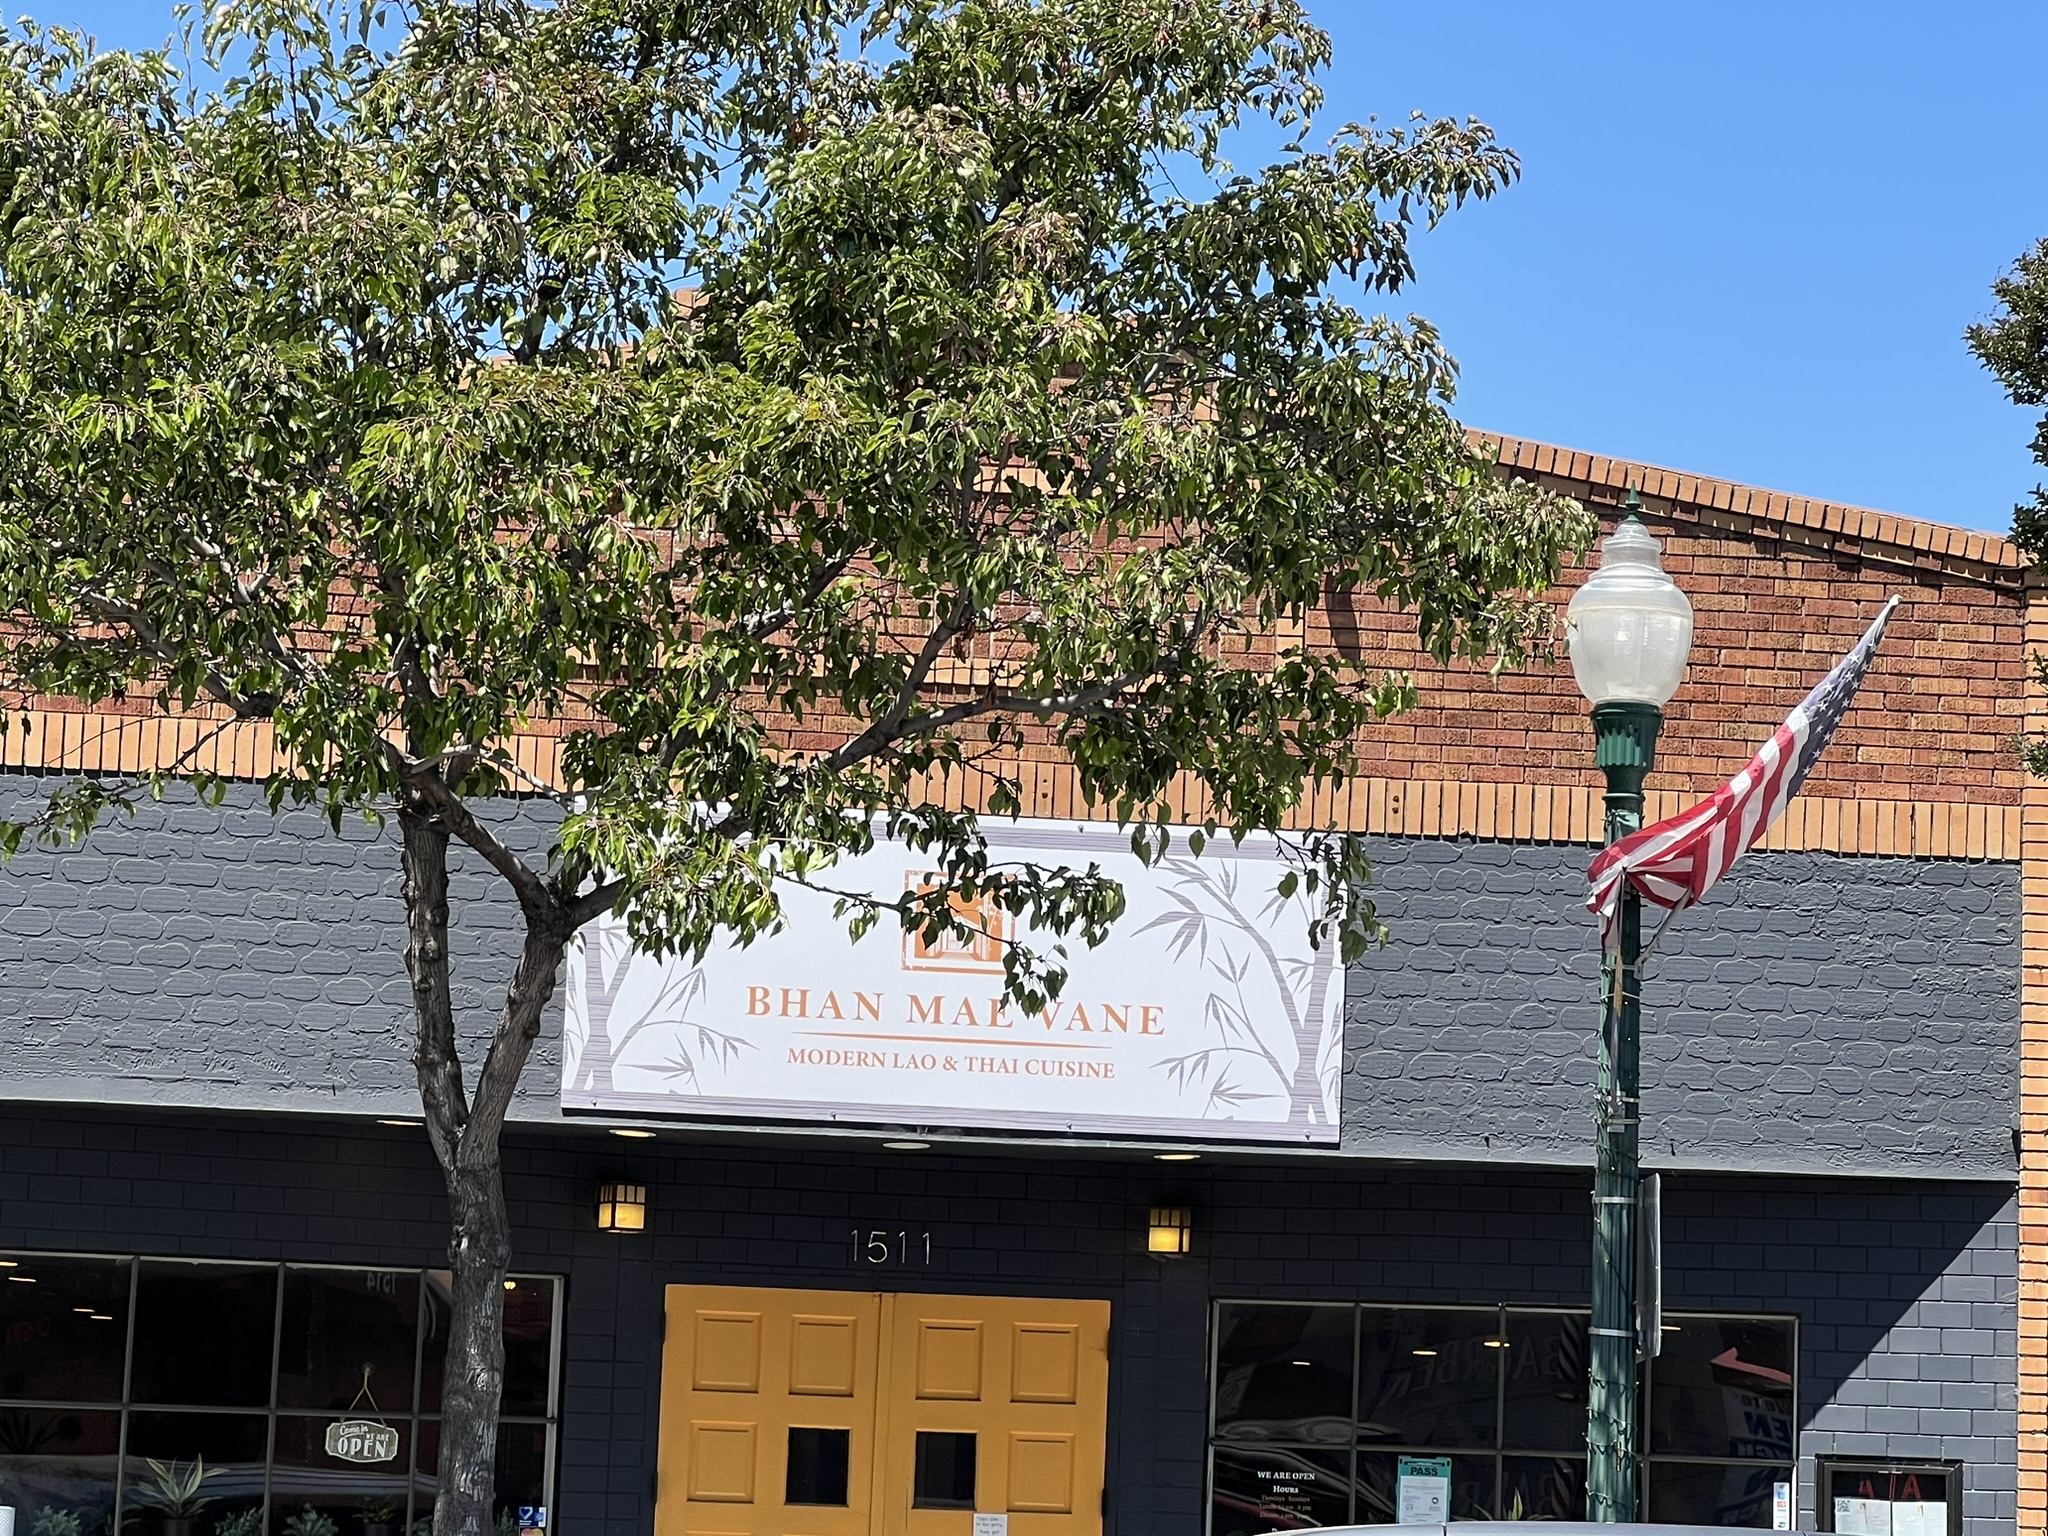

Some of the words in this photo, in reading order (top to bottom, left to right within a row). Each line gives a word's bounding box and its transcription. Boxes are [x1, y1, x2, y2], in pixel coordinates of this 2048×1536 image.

[745, 985, 885, 1022] BHAN
[906, 994, 1014, 1028] MAE
[1037, 1001, 1166, 1036] VANE
[787, 1048, 886, 1068] MODERN
[892, 1053, 937, 1070] LAO
[942, 1055, 958, 1071] &
[964, 1056, 1018, 1074] THAI
[1025, 1059, 1115, 1079] CUISINE
[848, 1229, 931, 1265] 1511
[337, 1437, 387, 1458] OPEN
[1257, 1471, 1272, 1479] WE
[1273, 1472, 1291, 1480] ARE
[1292, 1472, 1316, 1480] OPEN
[1410, 1467, 1438, 1476] PASS
